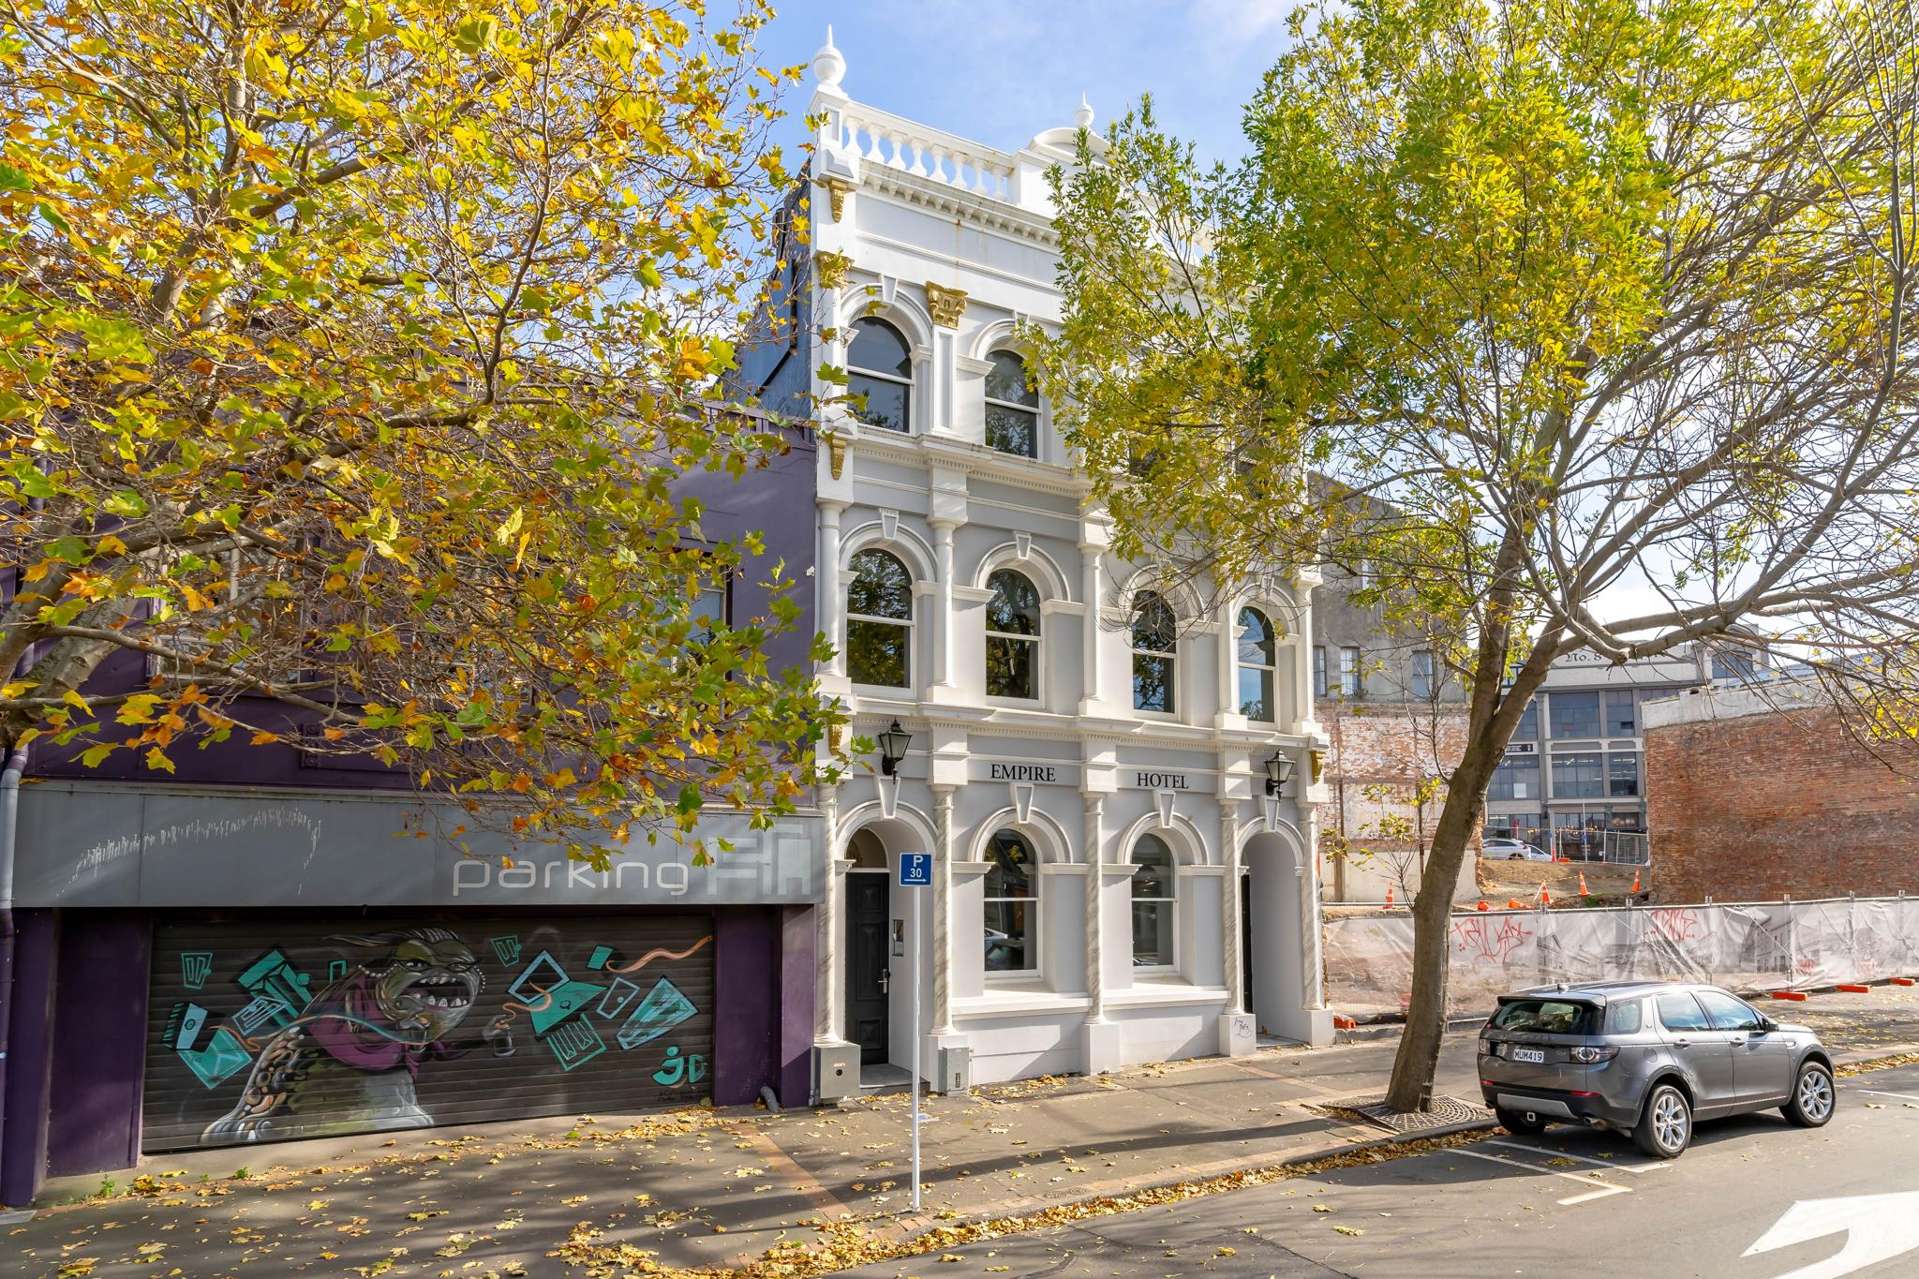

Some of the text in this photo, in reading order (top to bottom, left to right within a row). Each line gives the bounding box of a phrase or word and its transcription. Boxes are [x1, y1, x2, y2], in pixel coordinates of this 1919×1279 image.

[991, 763, 1189, 789] EMPIRE HOTEL
[913, 855, 924, 867] P
[910, 868, 922, 878] 30
